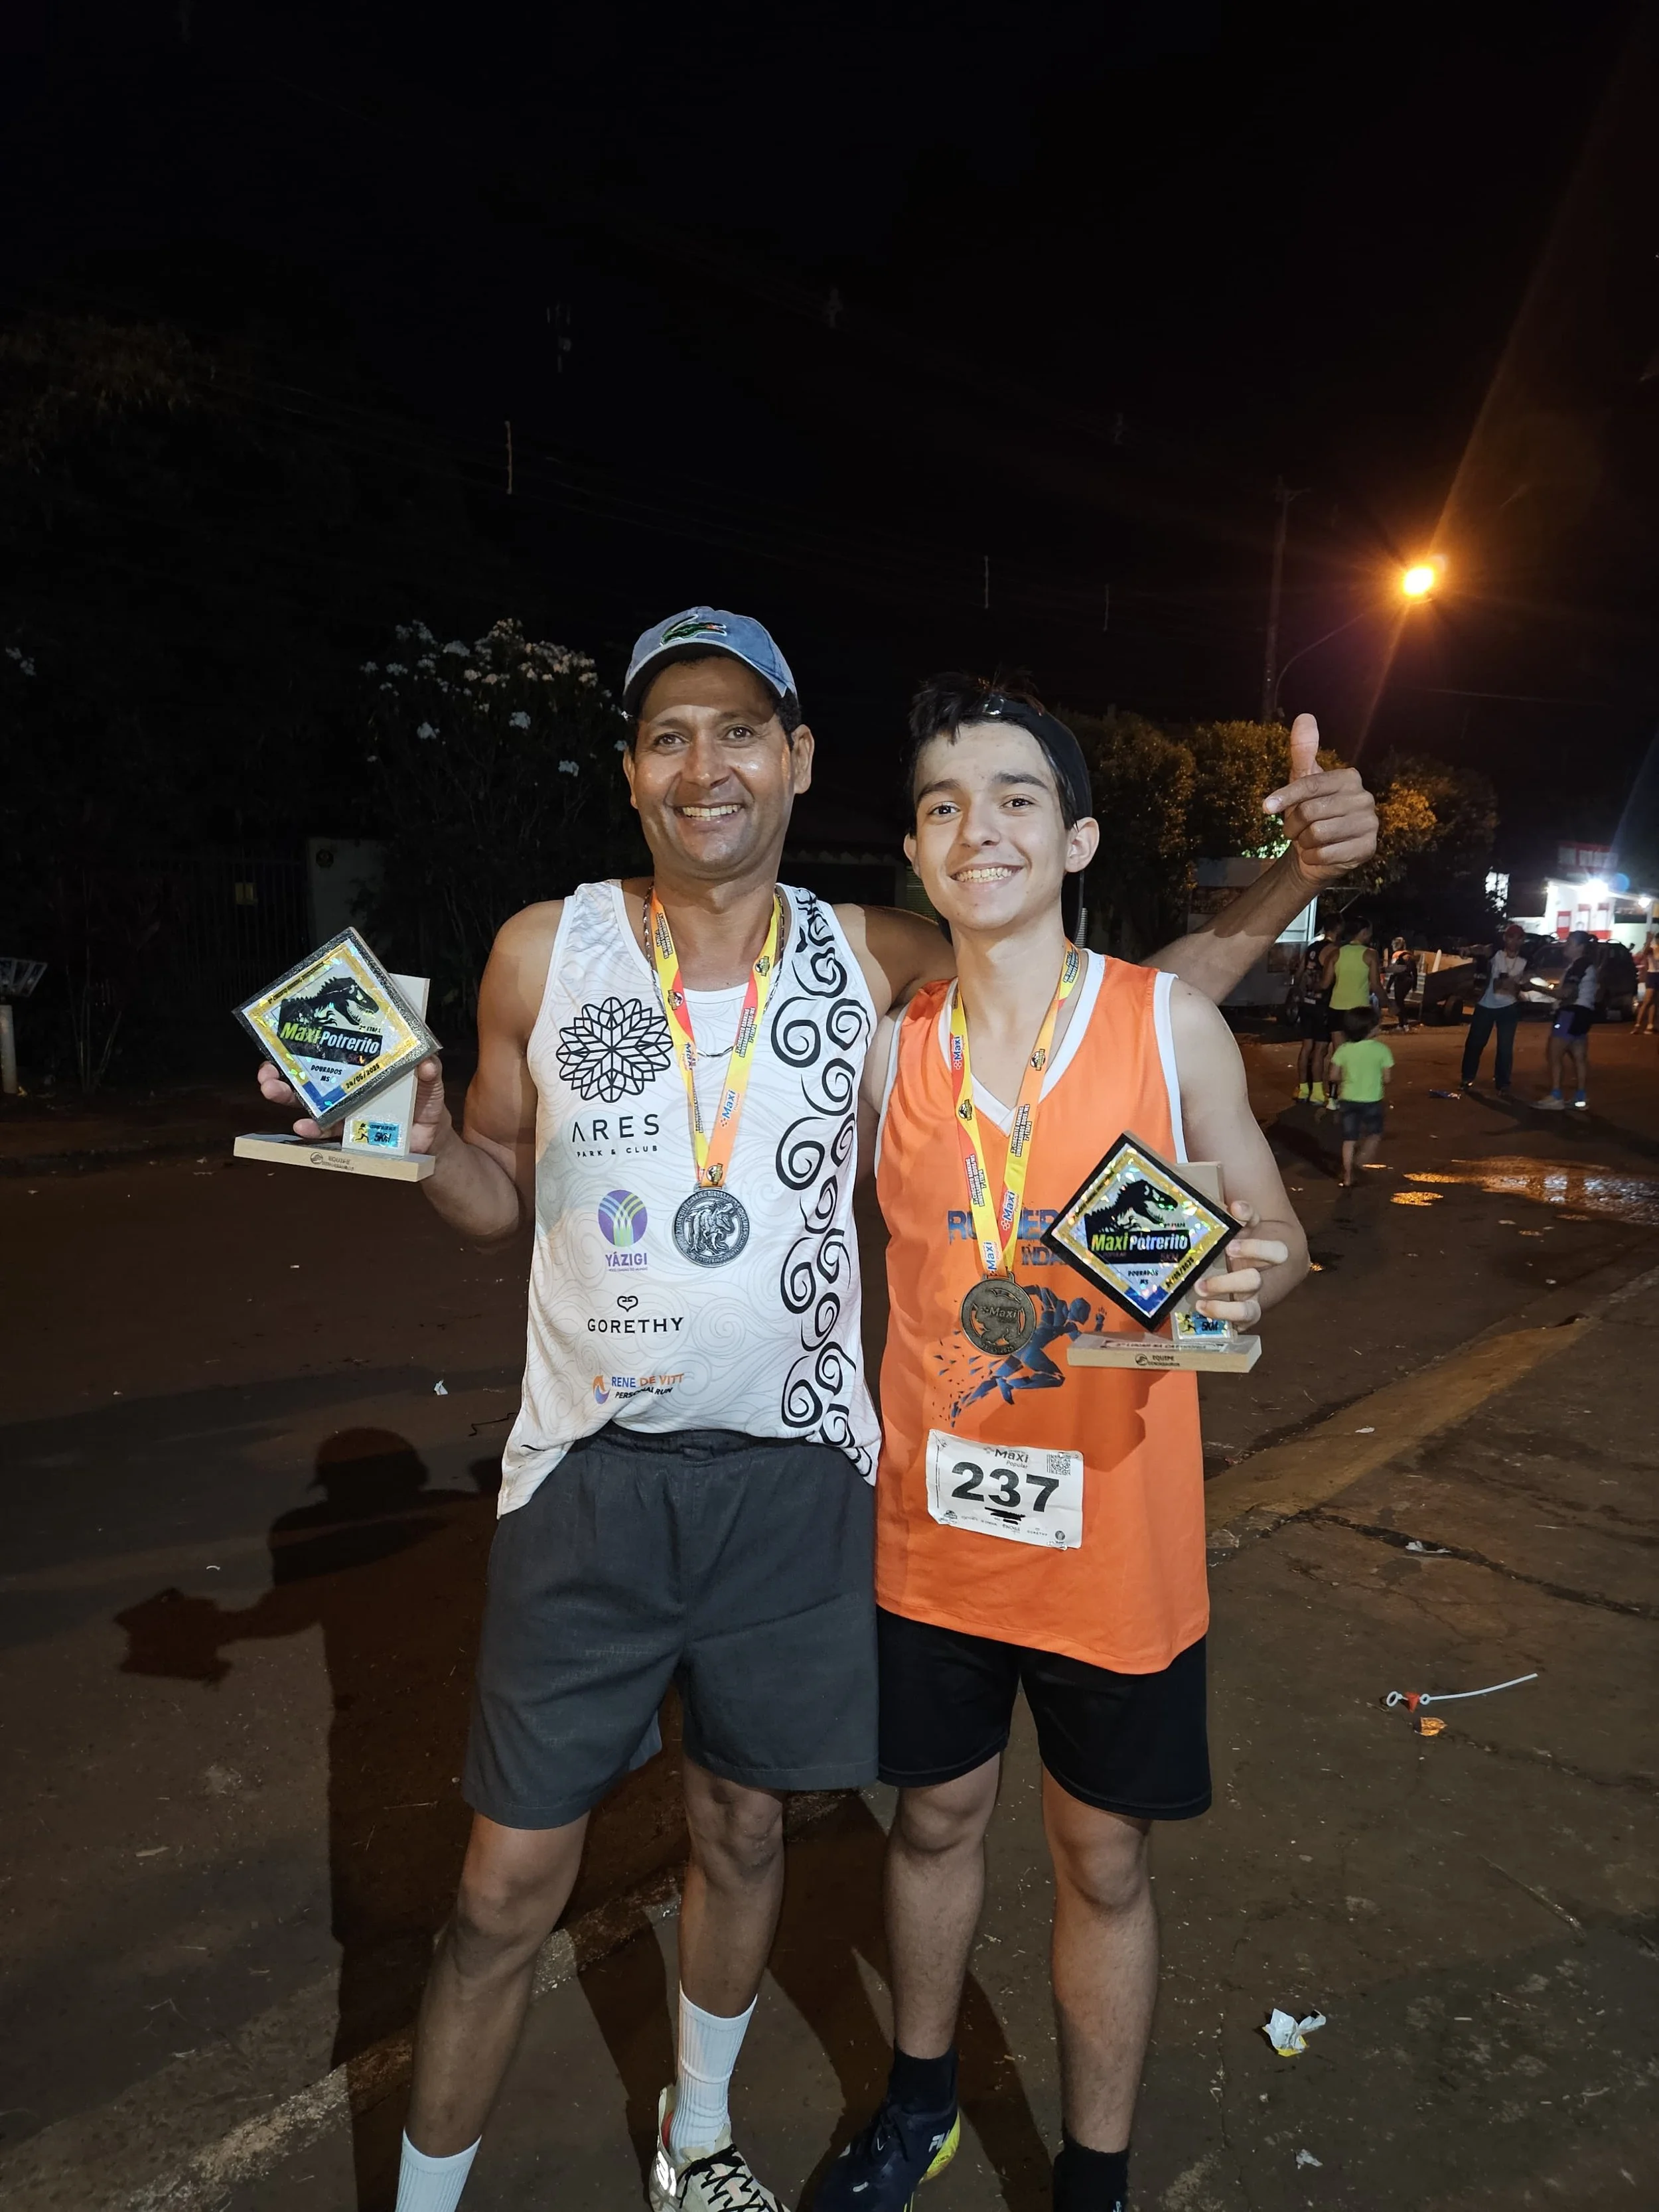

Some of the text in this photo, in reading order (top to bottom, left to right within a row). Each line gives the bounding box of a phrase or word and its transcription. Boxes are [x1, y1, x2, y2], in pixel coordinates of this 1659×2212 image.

[280, 1022, 323, 1044] Maxi
[319, 1031, 380, 1054] Potrerito
[953, 1036, 962, 1060] Maxi
[311, 1065, 342, 1075] DOURADOS
[721, 1090, 735, 1119] Maxi
[572, 1114, 659, 1142] ARES
[1003, 1191, 1015, 1221] Maxi
[1092, 1232, 1188, 1251] Maxi Potrerito
[605, 1251, 648, 1267] YÁZIGI
[983, 1242, 997, 1270] Maxi
[989, 1307, 1017, 1318] Maxi
[587, 1317, 684, 1333] GORETHY
[612, 1373, 684, 1388] RENE DE VITT
[995, 1449, 1029, 1463] Maxi
[1006, 1460, 1028, 1469] Popular
[952, 1461, 1059, 1512] 237
